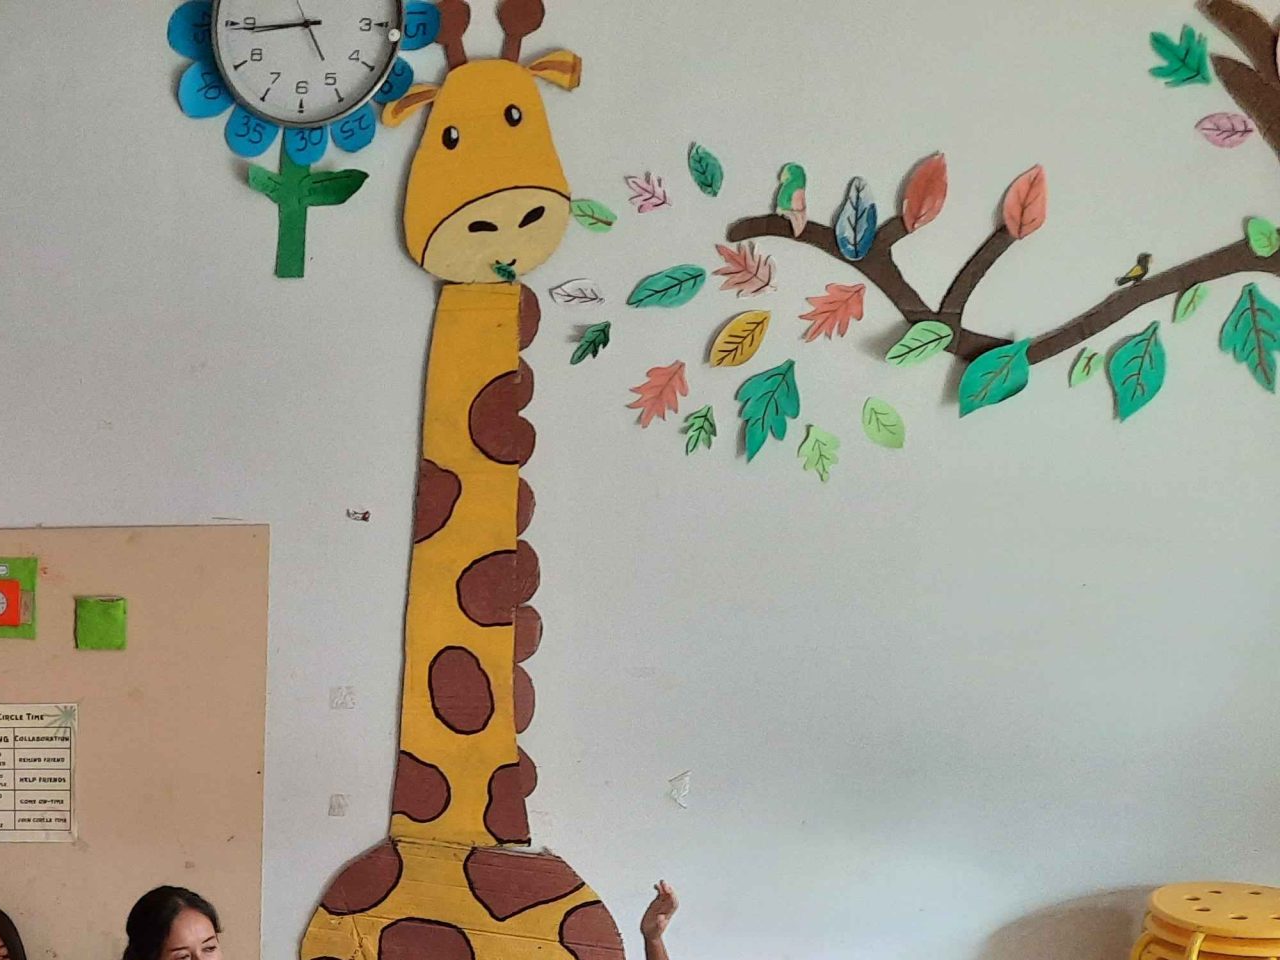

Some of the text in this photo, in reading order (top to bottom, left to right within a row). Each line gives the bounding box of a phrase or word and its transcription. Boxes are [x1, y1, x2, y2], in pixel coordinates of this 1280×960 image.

[359, 17, 372, 31] 3
[250, 48, 263, 62] 8
[348, 49, 360, 62] 4
[269, 71, 282, 84] 7
[324, 72, 337, 86] 5
[295, 80, 309, 95] 6
[235, 115, 265, 144] 35
[296, 127, 324, 152] 30
[26, 712, 44, 721] TIME
